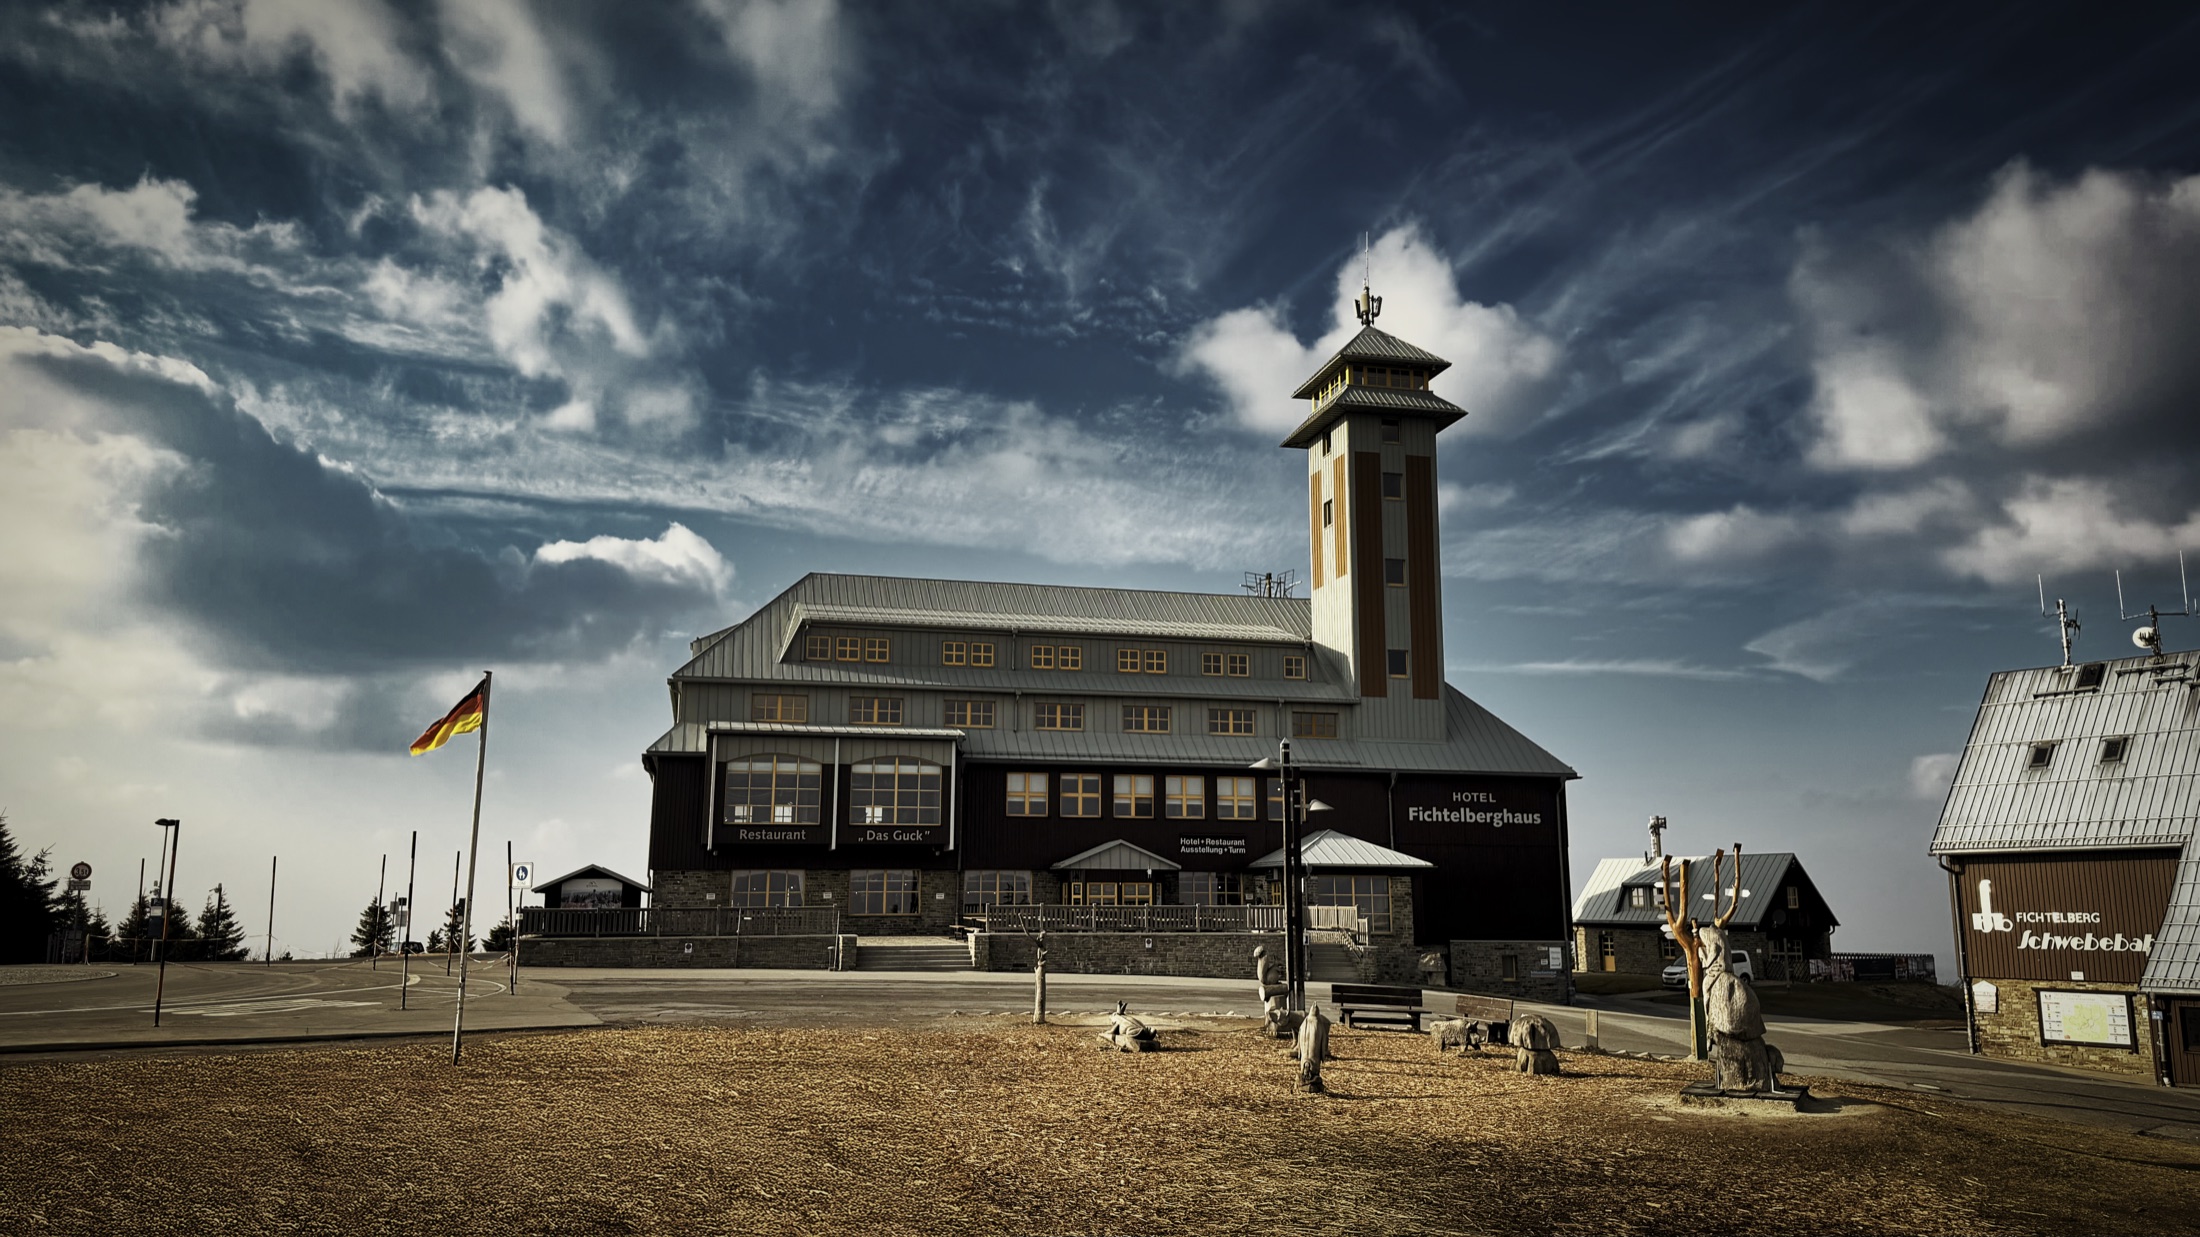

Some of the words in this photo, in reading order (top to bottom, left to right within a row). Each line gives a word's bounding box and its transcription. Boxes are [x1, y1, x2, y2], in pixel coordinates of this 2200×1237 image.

[1452, 792, 1496, 803] HOTEL
[1408, 806, 1541, 828] Fichtelberghaus
[739, 829, 806, 840] Restaurant
[1180, 837, 1200, 846] Hotel
[1205, 837, 1245, 846] Restaurant
[1180, 845, 1223, 855] Ausstellung
[1228, 846, 1246, 854] Turm
[2015, 911, 2101, 924] FICHTELBERG
